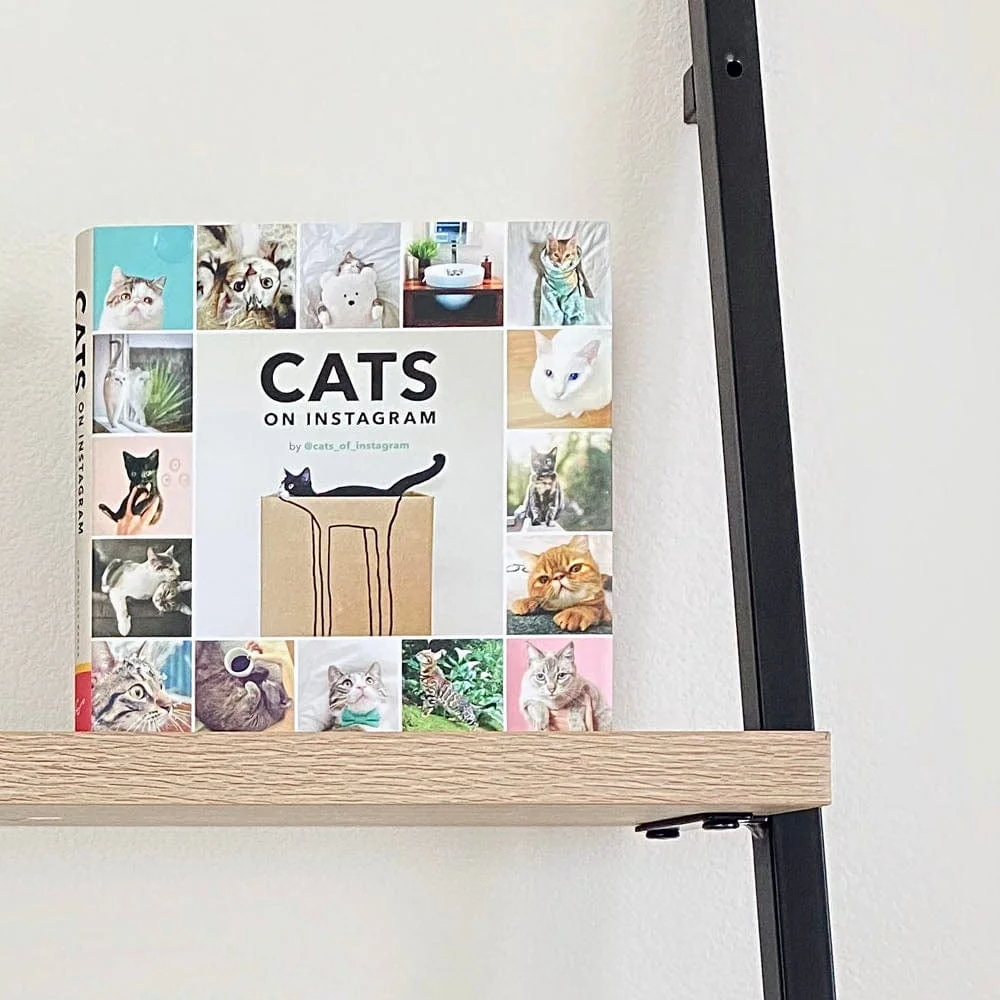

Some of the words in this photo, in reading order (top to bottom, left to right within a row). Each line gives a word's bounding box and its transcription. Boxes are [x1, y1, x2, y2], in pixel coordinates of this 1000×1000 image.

[75, 290, 87, 394] CATS
[260, 350, 438, 403] CATS
[78, 401, 85, 427] ON
[264, 412, 295, 426] ON
[306, 411, 436, 426] INSTAGRAM
[289, 441, 302, 453] by
[304, 441, 410, 452] @cats_of_instagram
